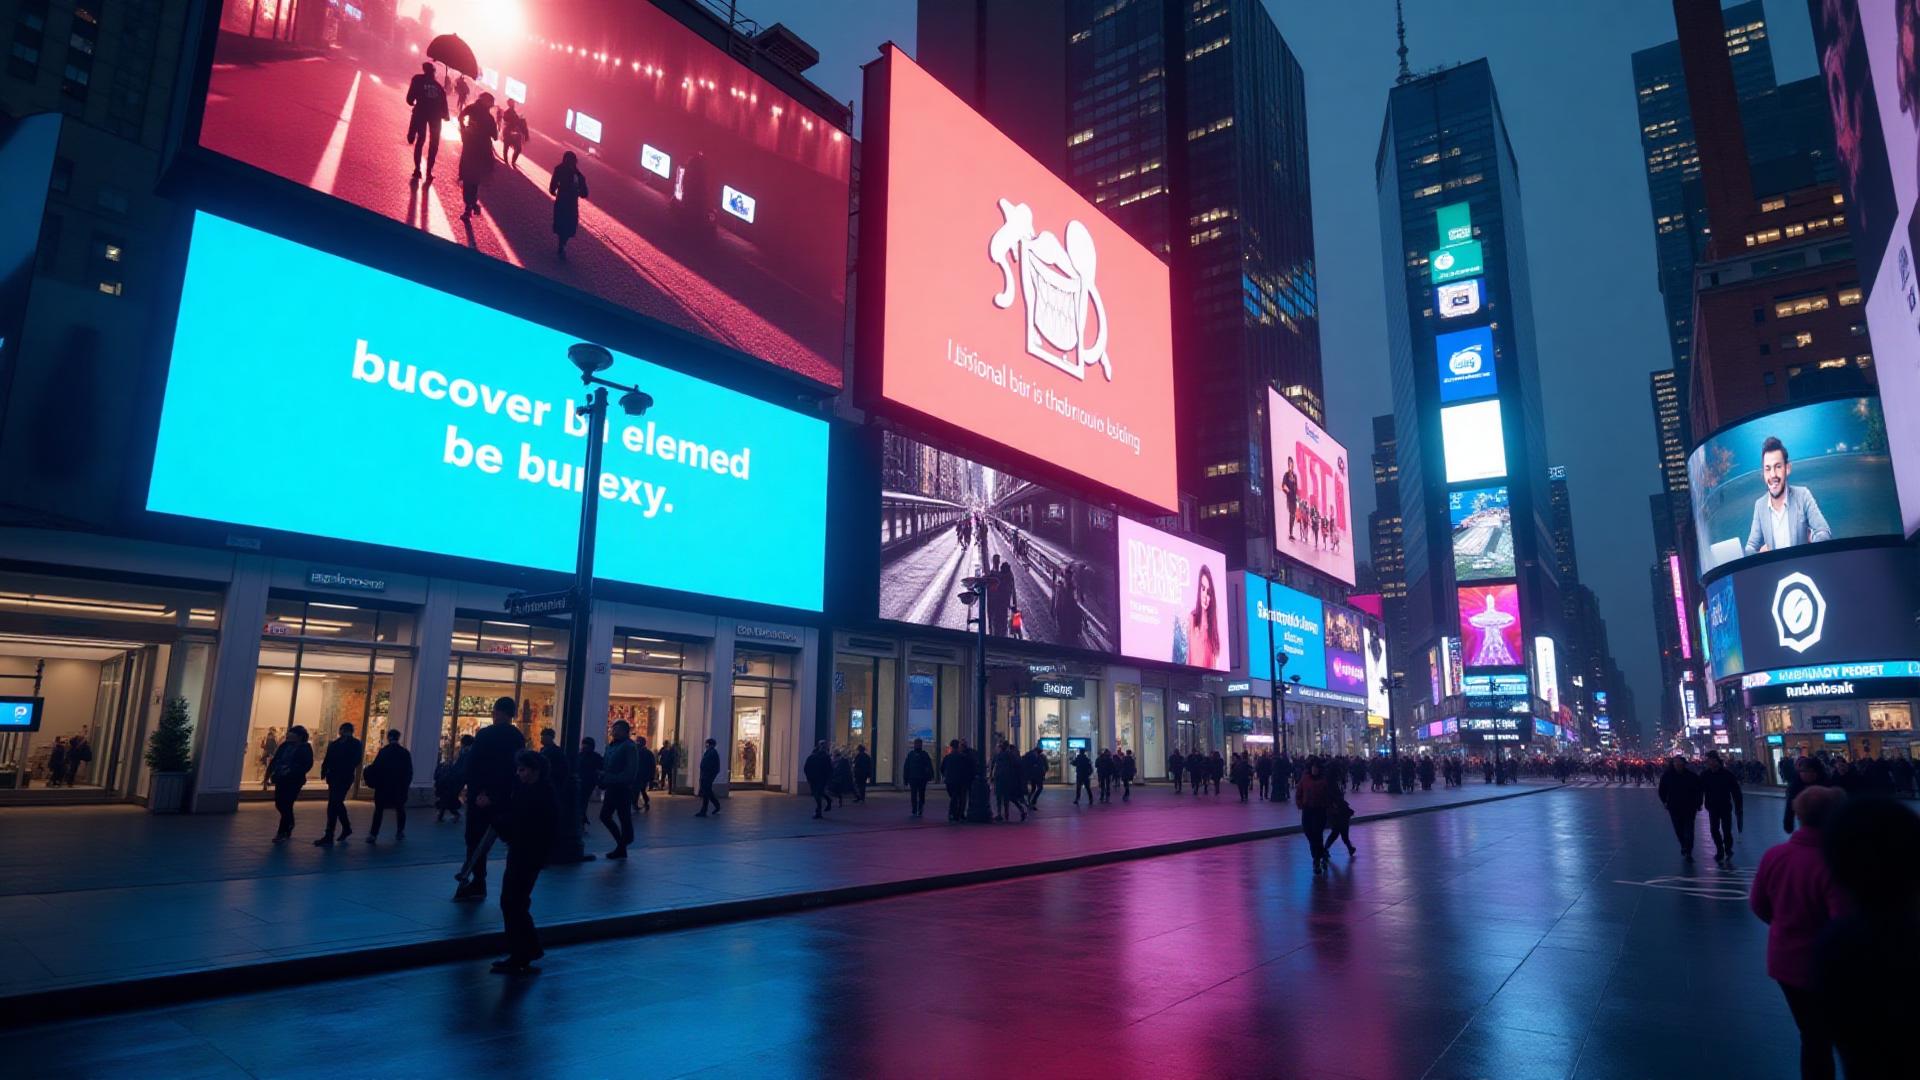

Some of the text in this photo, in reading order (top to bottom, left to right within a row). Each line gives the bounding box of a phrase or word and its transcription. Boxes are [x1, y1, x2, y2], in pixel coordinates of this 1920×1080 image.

[351, 338, 551, 426] bucover
[622, 421, 750, 480] elemed
[443, 424, 503, 474] be
